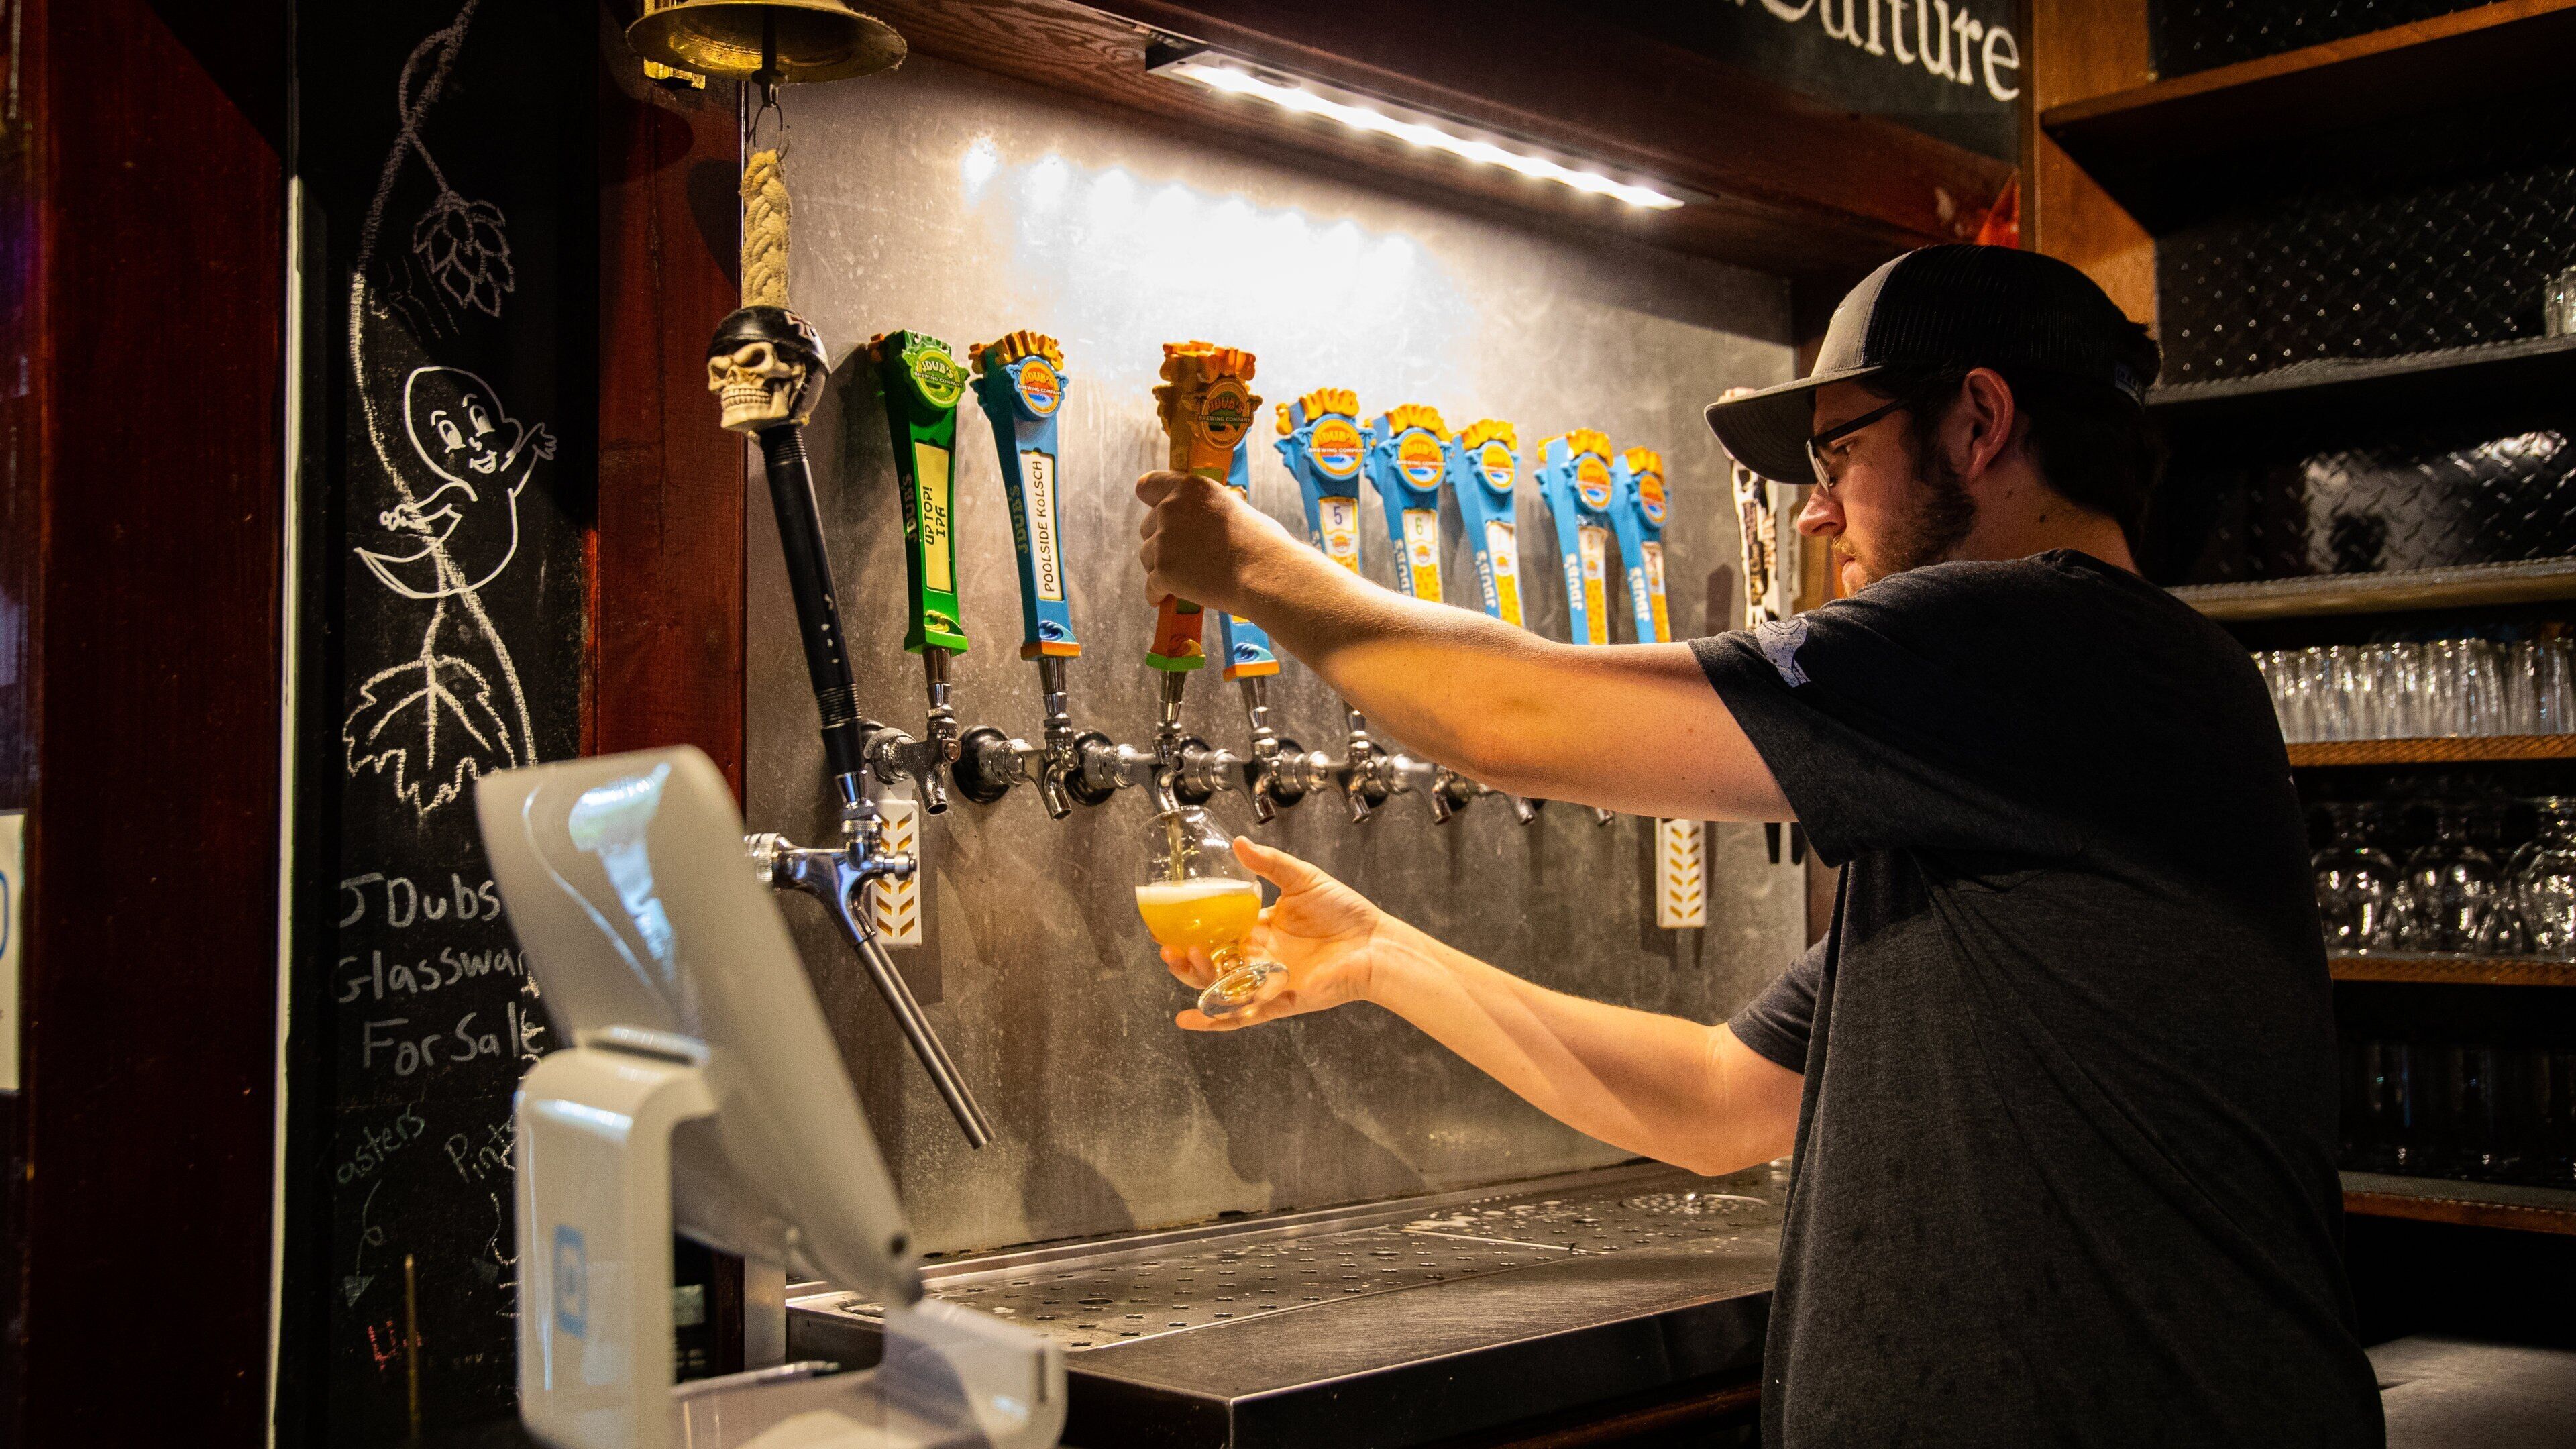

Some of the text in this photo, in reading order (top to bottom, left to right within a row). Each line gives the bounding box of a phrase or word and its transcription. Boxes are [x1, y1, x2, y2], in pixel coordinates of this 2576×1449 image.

[1755, 0, 2020, 101] ulture
[914, 371, 963, 388] BREWING COMPANY
[922, 360, 954, 378] JDUB'S
[1017, 384, 1062, 396] BREWING COMPANY
[935, 505, 946, 538] IPA
[1008, 484, 1028, 553] JDUB'S
[1333, 505, 1342, 525] 5
[1415, 517, 1423, 535] 6
[924, 524, 934, 545] UP
[1038, 521, 1055, 592] POOLSIDE
[338, 946, 526, 1004] Glasswar
[363, 1018, 441, 1075] For
[337, 1102, 425, 1185] asters
